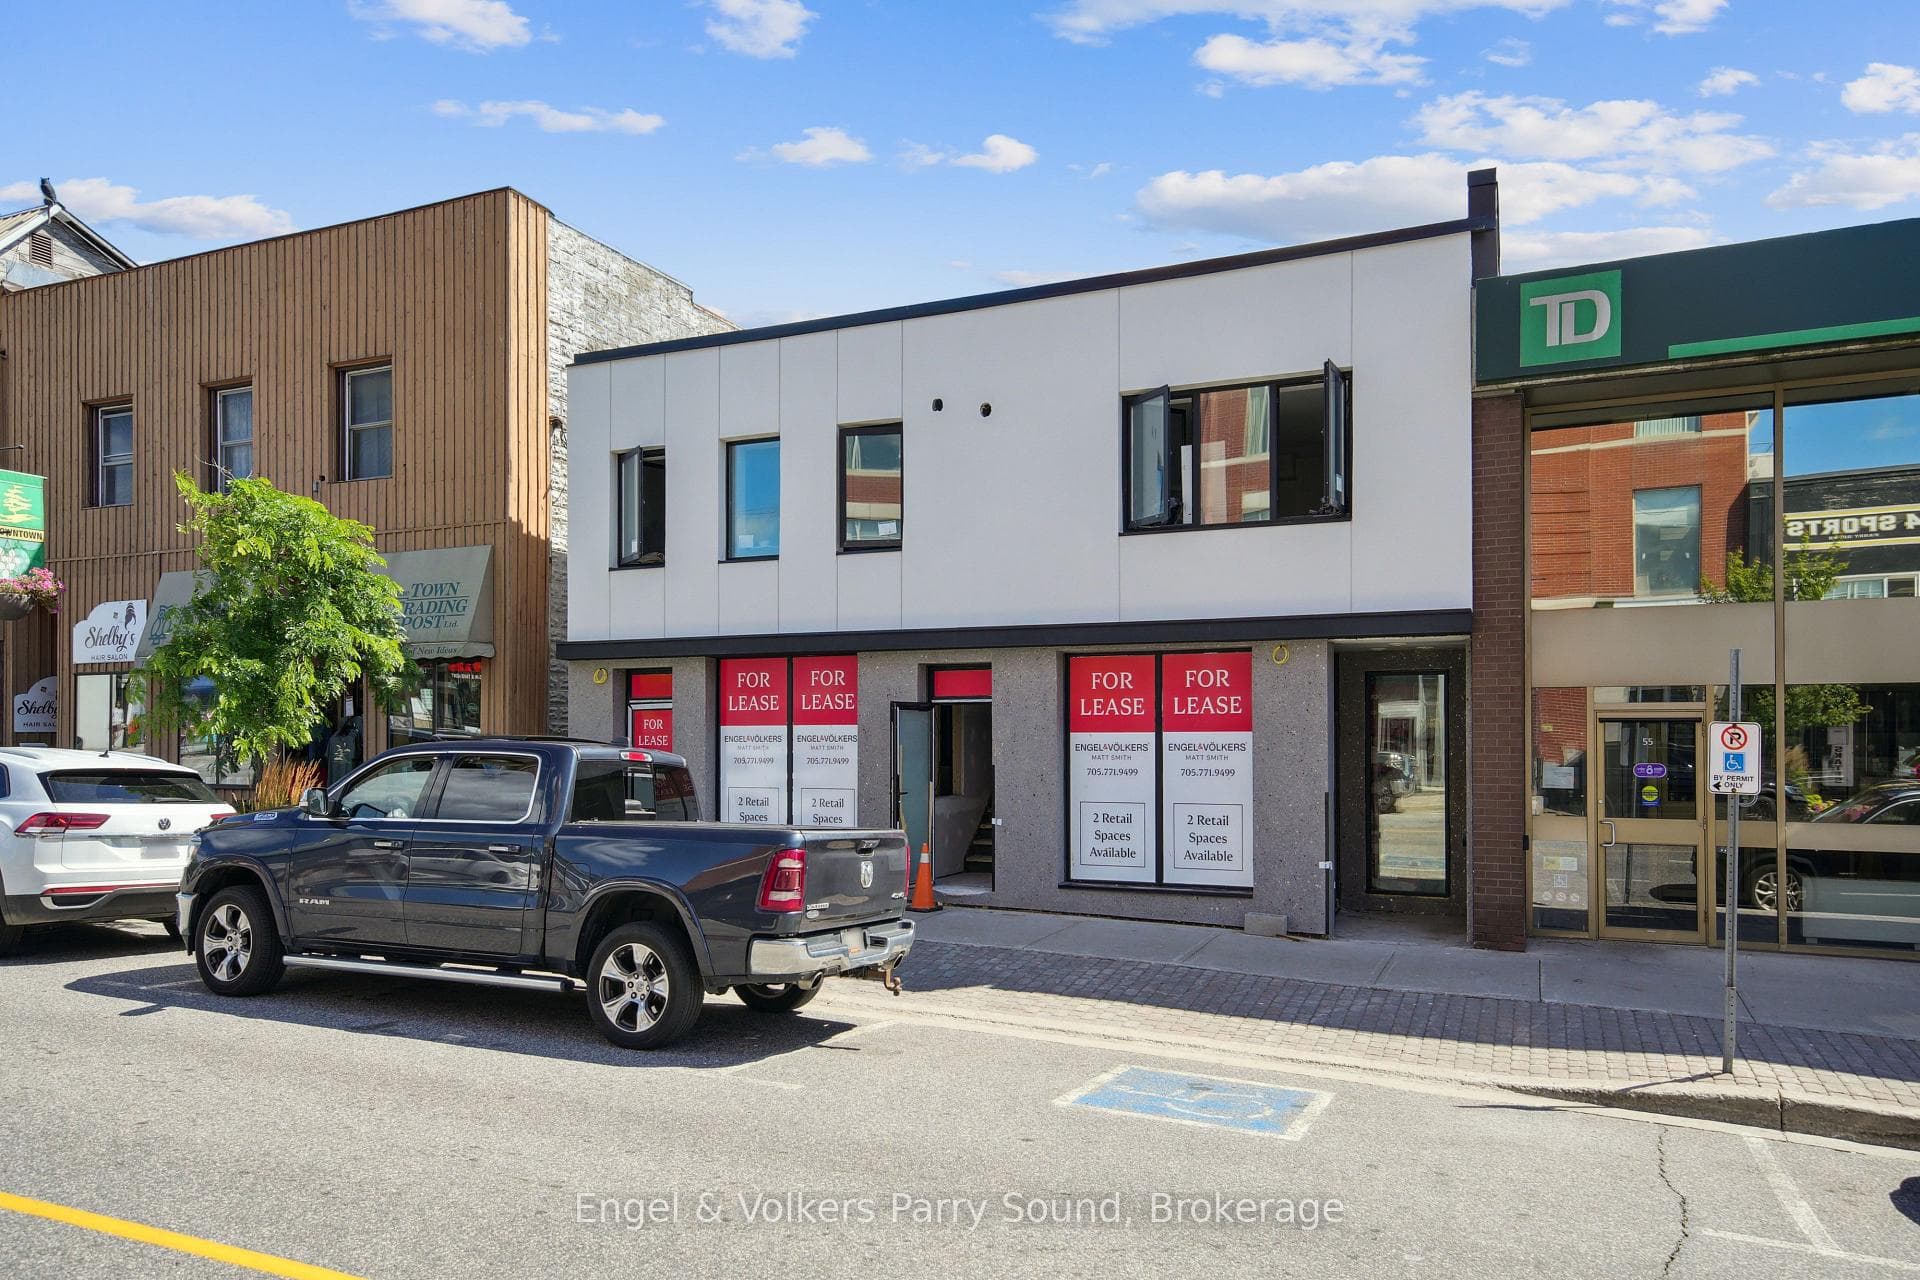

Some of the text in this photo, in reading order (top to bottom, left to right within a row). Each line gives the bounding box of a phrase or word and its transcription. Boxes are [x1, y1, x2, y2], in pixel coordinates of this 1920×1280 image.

[1530, 290, 1611, 347] TD
[0, 528, 43, 540] OWNTOWN
[411, 582, 460, 597] TOWN
[400, 615, 445, 630] POST
[85, 625, 136, 652] Shelby's
[737, 672, 770, 688] FOR
[810, 670, 846, 686] FOR
[1091, 672, 1133, 689] FOR
[1185, 669, 1230, 688] FOR
[728, 695, 779, 711] LEASE
[801, 693, 855, 710] LEASE
[1080, 698, 1145, 716] LEASE
[1173, 696, 1243, 714] LEASE
[17, 700, 57, 719] Shelb
[643, 719, 663, 730] FOR
[638, 735, 668, 746] LEASE
[1642, 738, 1653, 746] 55
[1087, 768, 1138, 776] 705.771.9499
[1180, 768, 1235, 777] 705.771.9499
[738, 797, 769, 806] 2 Retail
[812, 798, 844, 808] 2 Retail
[739, 812, 768, 823] Spaces
[812, 813, 843, 825] Spaces
[1093, 813, 1133, 824] 2 Retail
[1187, 815, 1229, 826] 2 Retail
[1094, 830, 1131, 842] Spaces
[1189, 832, 1228, 845] Spaces
[1090, 847, 1136, 859] Available
[1184, 850, 1233, 862] Available
